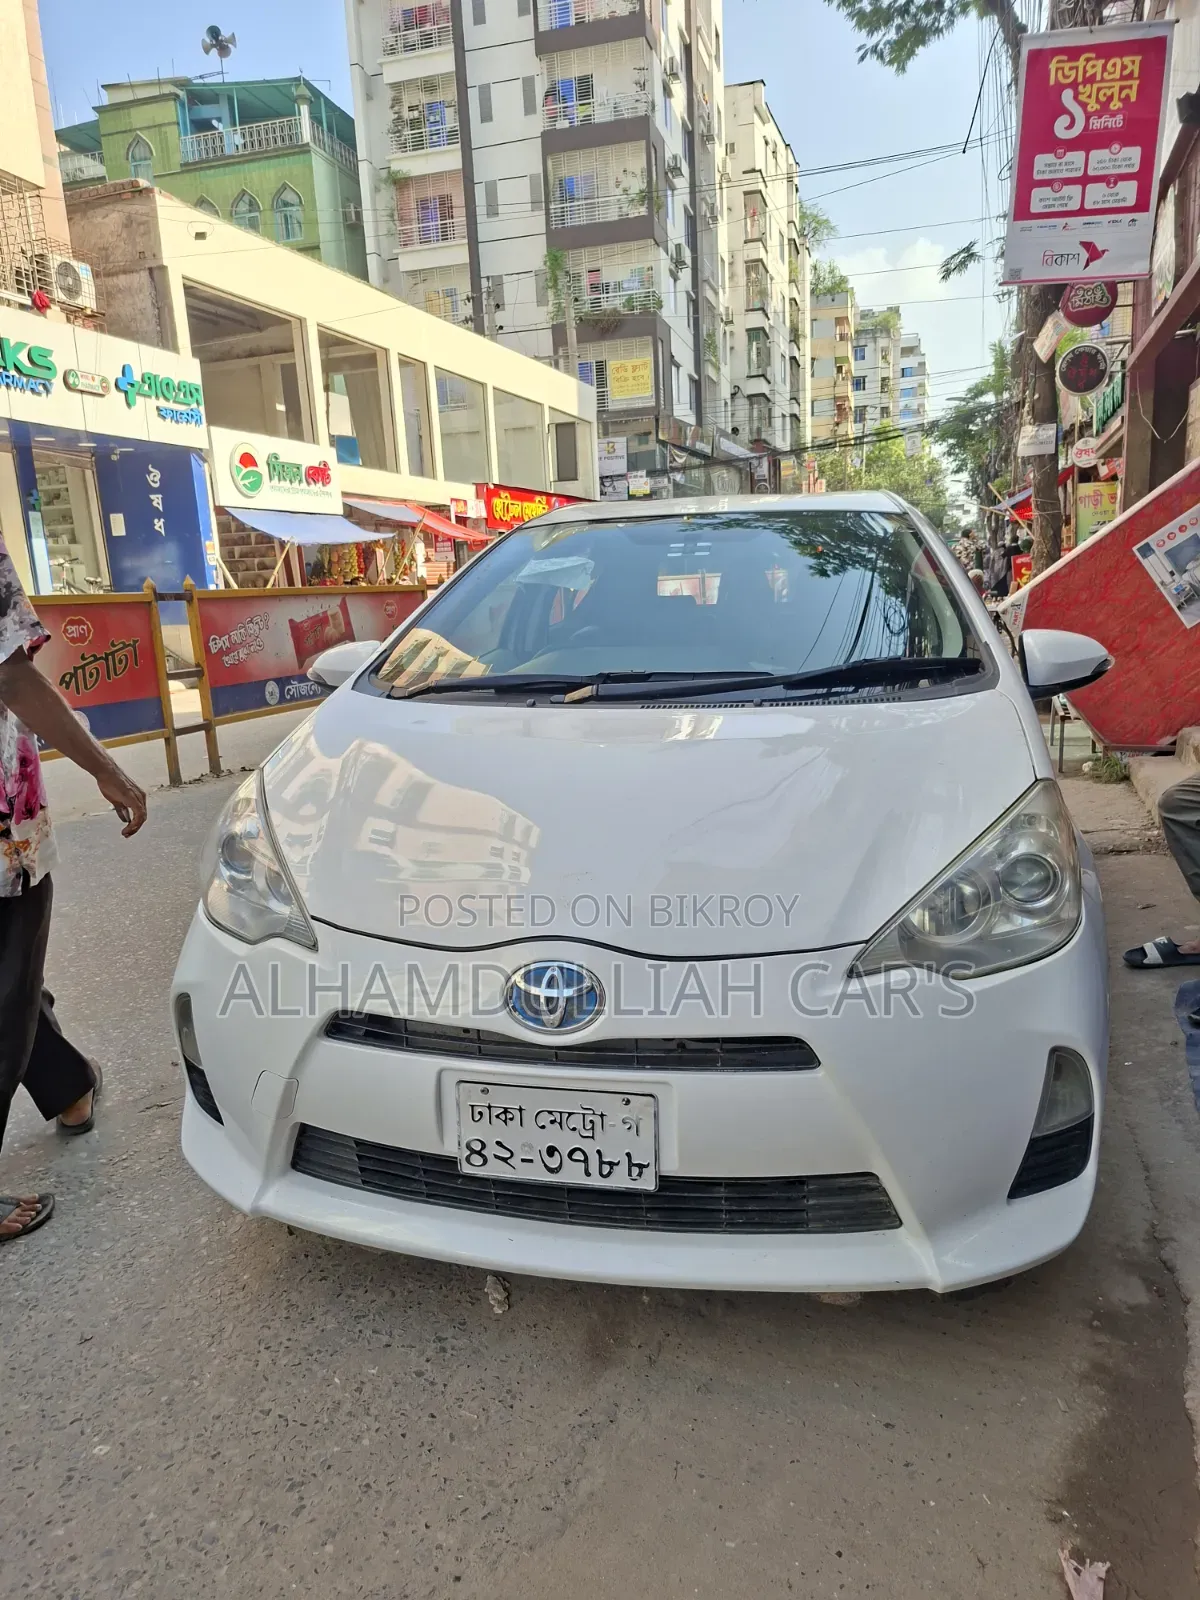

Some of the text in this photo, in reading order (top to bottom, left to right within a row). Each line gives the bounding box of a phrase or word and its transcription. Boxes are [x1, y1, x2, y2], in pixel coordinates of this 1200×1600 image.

[1049, 54, 1142, 86] ডিপিএস
[1078, 78, 1140, 111] খুলুন
[1054, 88, 1124, 140] ১ মিনিটে
[1042, 249, 1081, 267] বিকাশ
[0, 337, 57, 380] KS
[66, 624, 88, 638] প্রাণ
[59, 638, 140, 696] পটাটা
[468, 1103, 525, 1127] ঢাকা
[465, 1137, 650, 1181] ৪২-৩৭৮৮
